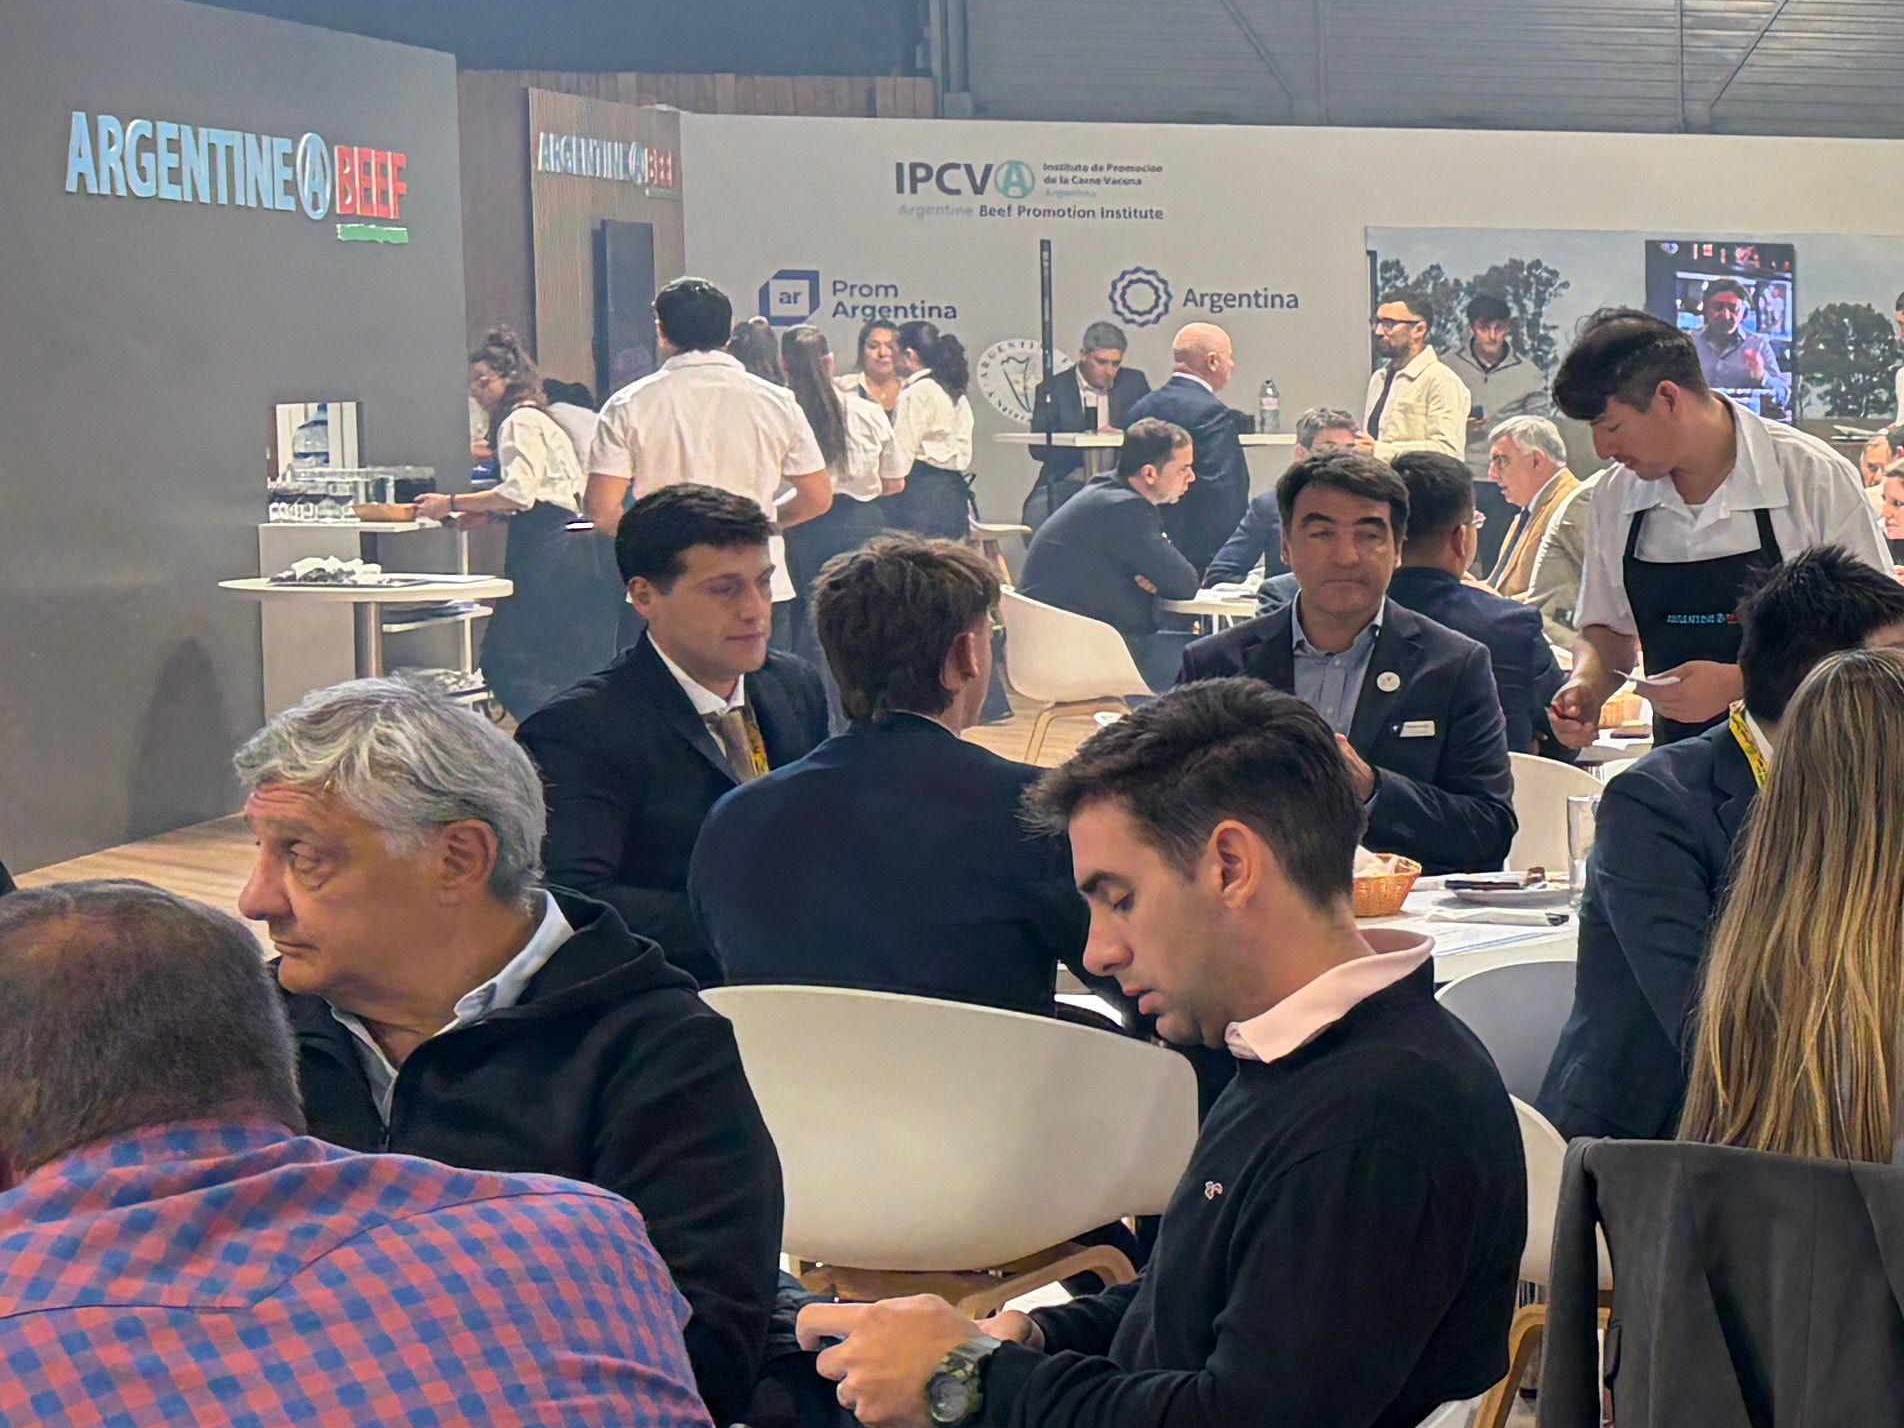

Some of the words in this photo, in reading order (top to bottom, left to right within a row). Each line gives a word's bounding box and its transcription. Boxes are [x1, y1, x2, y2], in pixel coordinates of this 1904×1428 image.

[65, 111, 296, 212] ARGENTINE
[334, 145, 407, 220] BEEF
[1071, 176, 1101, 186] Carne
[898, 204, 974, 220] Argentine
[979, 204, 1012, 218] Beef
[1017, 205, 1096, 219] Promotion
[1100, 205, 1164, 220] Institute
[778, 287, 802, 306] ar
[831, 279, 899, 298] Prom
[1182, 286, 1300, 314] Argentina
[831, 301, 958, 322] Argentina
